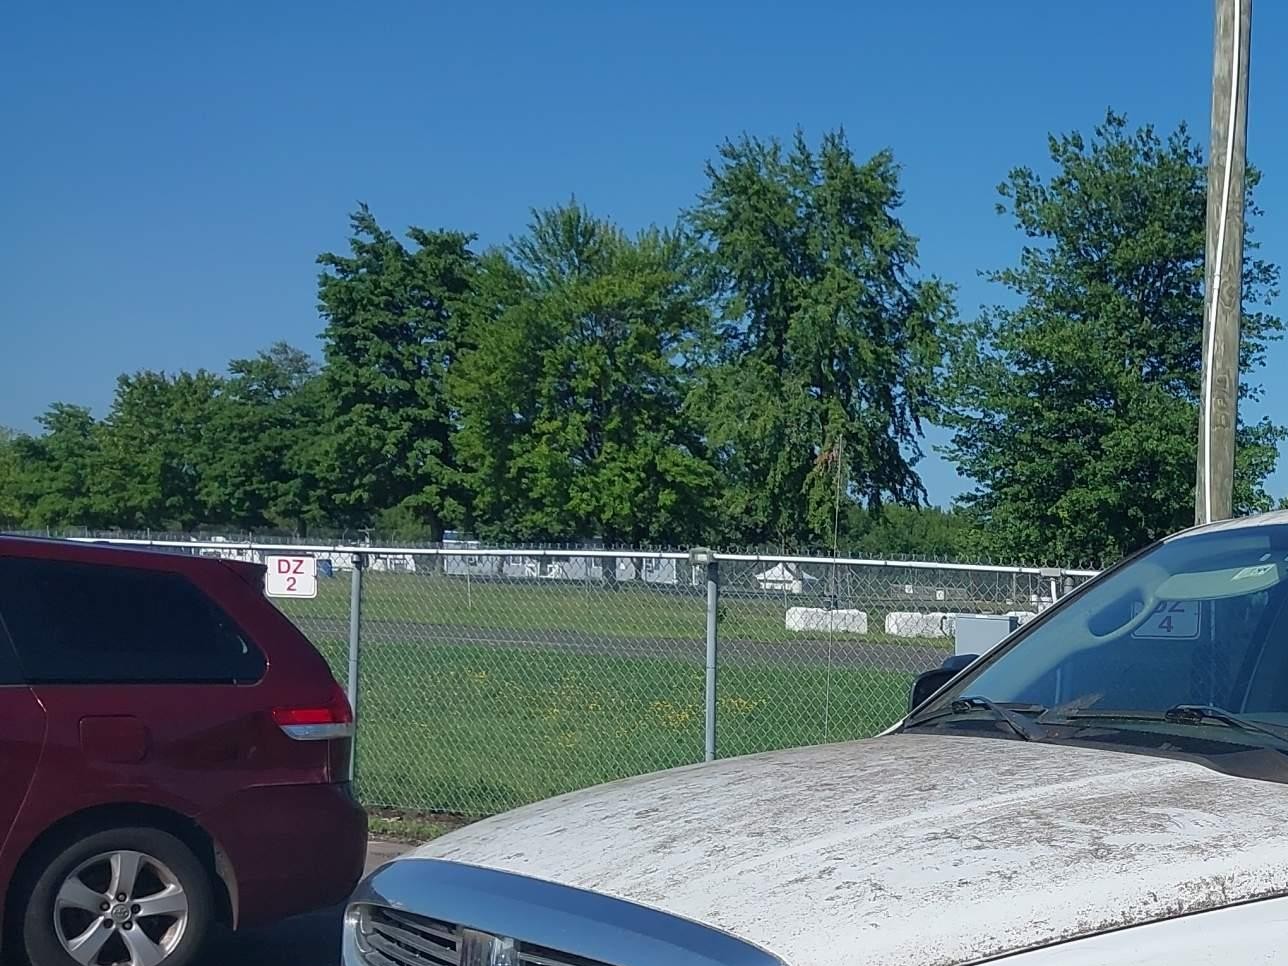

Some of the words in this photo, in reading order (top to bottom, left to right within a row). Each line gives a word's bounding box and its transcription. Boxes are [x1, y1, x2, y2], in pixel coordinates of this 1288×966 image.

[277, 559, 305, 575] DZ
[286, 577, 297, 591] 2
[1158, 615, 1174, 633] 4
